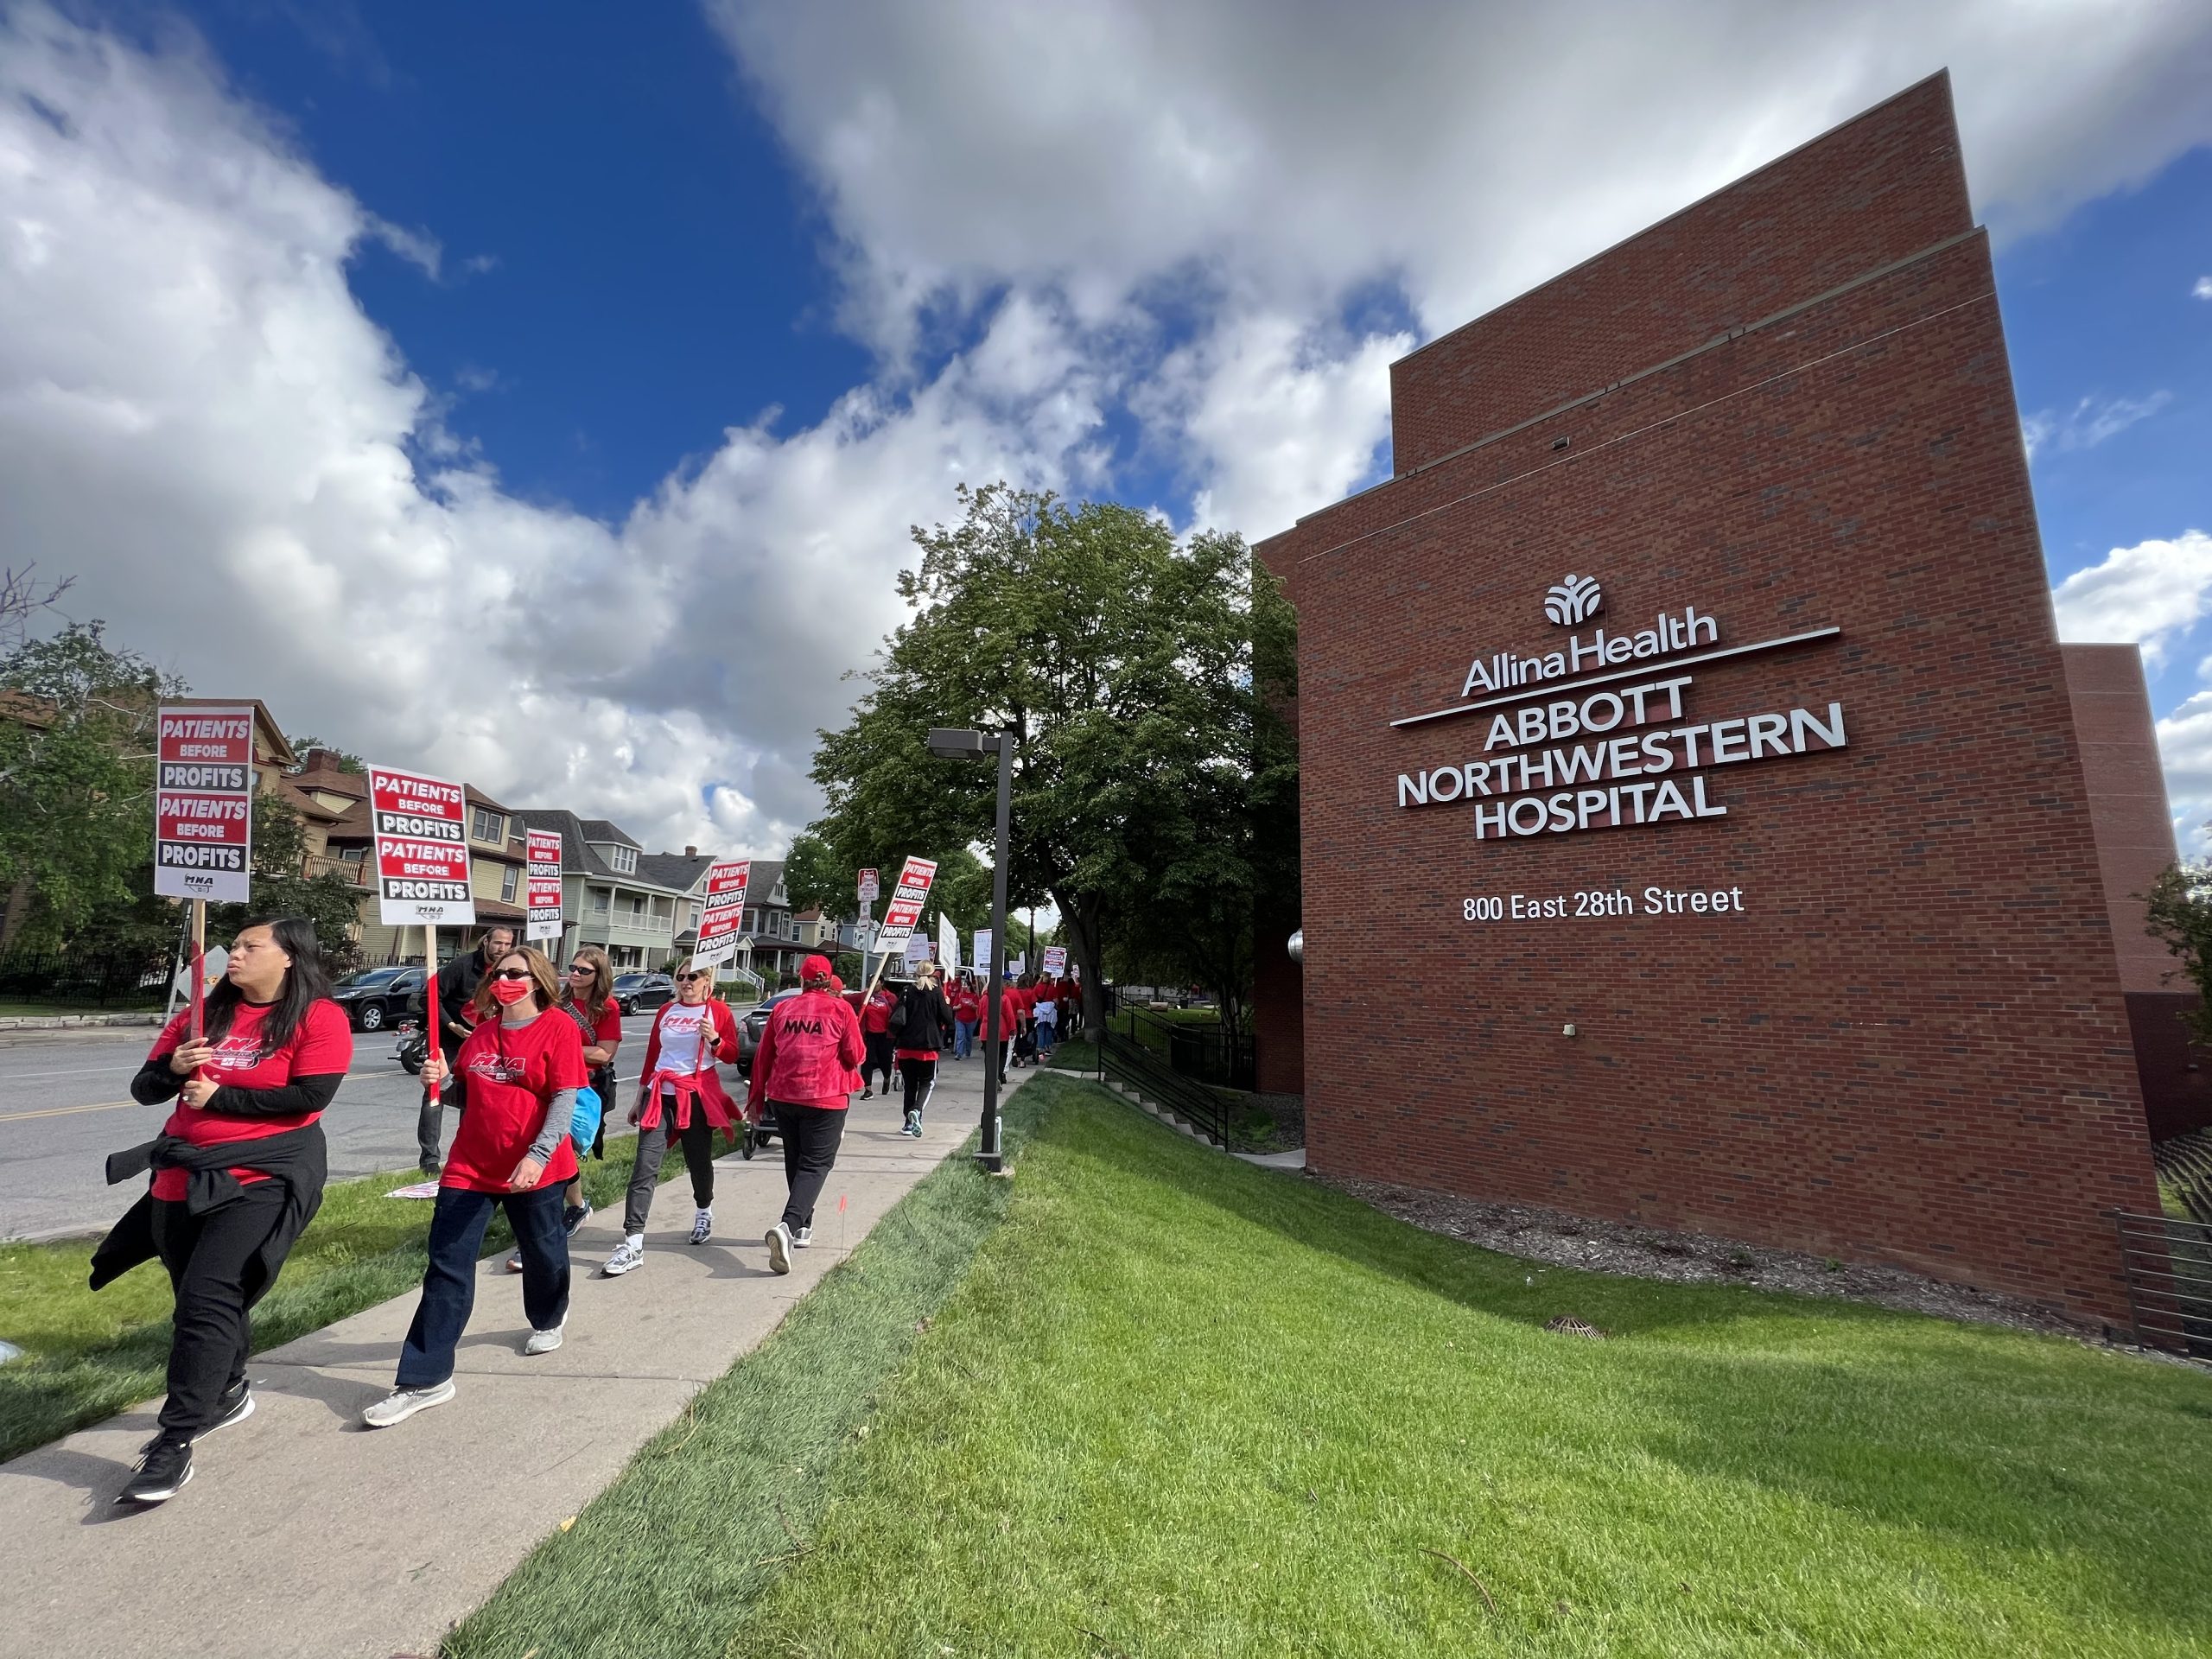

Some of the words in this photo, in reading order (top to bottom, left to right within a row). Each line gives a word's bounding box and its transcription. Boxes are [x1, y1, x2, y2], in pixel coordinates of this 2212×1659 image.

[1461, 652, 1566, 697] Allina
[1570, 607, 1718, 672] Health
[1484, 677, 1692, 751] ABBOTT
[162, 720, 249, 740] PATIENTS
[180, 744, 227, 758] BEFORE
[1398, 702, 1847, 807] NORTHWESTERN
[164, 766, 243, 788] PROFITS
[374, 776, 461, 804] PATIENTS
[160, 798, 246, 820] PATIENTS
[398, 798, 444, 815] BEFORE
[1475, 776, 1726, 839] HOSPITAL
[176, 823, 225, 838] BEFORE
[383, 816, 461, 840] PROFITS
[528, 836, 560, 850] PATIENTS
[162, 846, 241, 869] PROFITS
[380, 842, 466, 862] PATIENTS
[404, 862, 449, 876] BEFORE
[530, 864, 559, 876] PROFITS
[710, 864, 749, 880] PATIENTS
[906, 863, 935, 877] PATIENTS
[185, 874, 213, 885] MNA
[528, 881, 560, 893] PATIENTS
[389, 880, 467, 900] PROFITS
[708, 889, 743, 906] PROFITS
[897, 887, 925, 899] PROFITS
[890, 903, 922, 915] PATIENTS
[1464, 896, 1503, 920] 800
[1511, 893, 1567, 918] East
[1574, 890, 1633, 916] 28th
[1643, 886, 1745, 913] Street
[530, 909, 560, 921] PROFITS
[702, 906, 741, 925] PATIENTS
[882, 926, 911, 938] PROFITS
[699, 932, 735, 952] PROFITS
[784, 1020, 823, 1035] MNA
